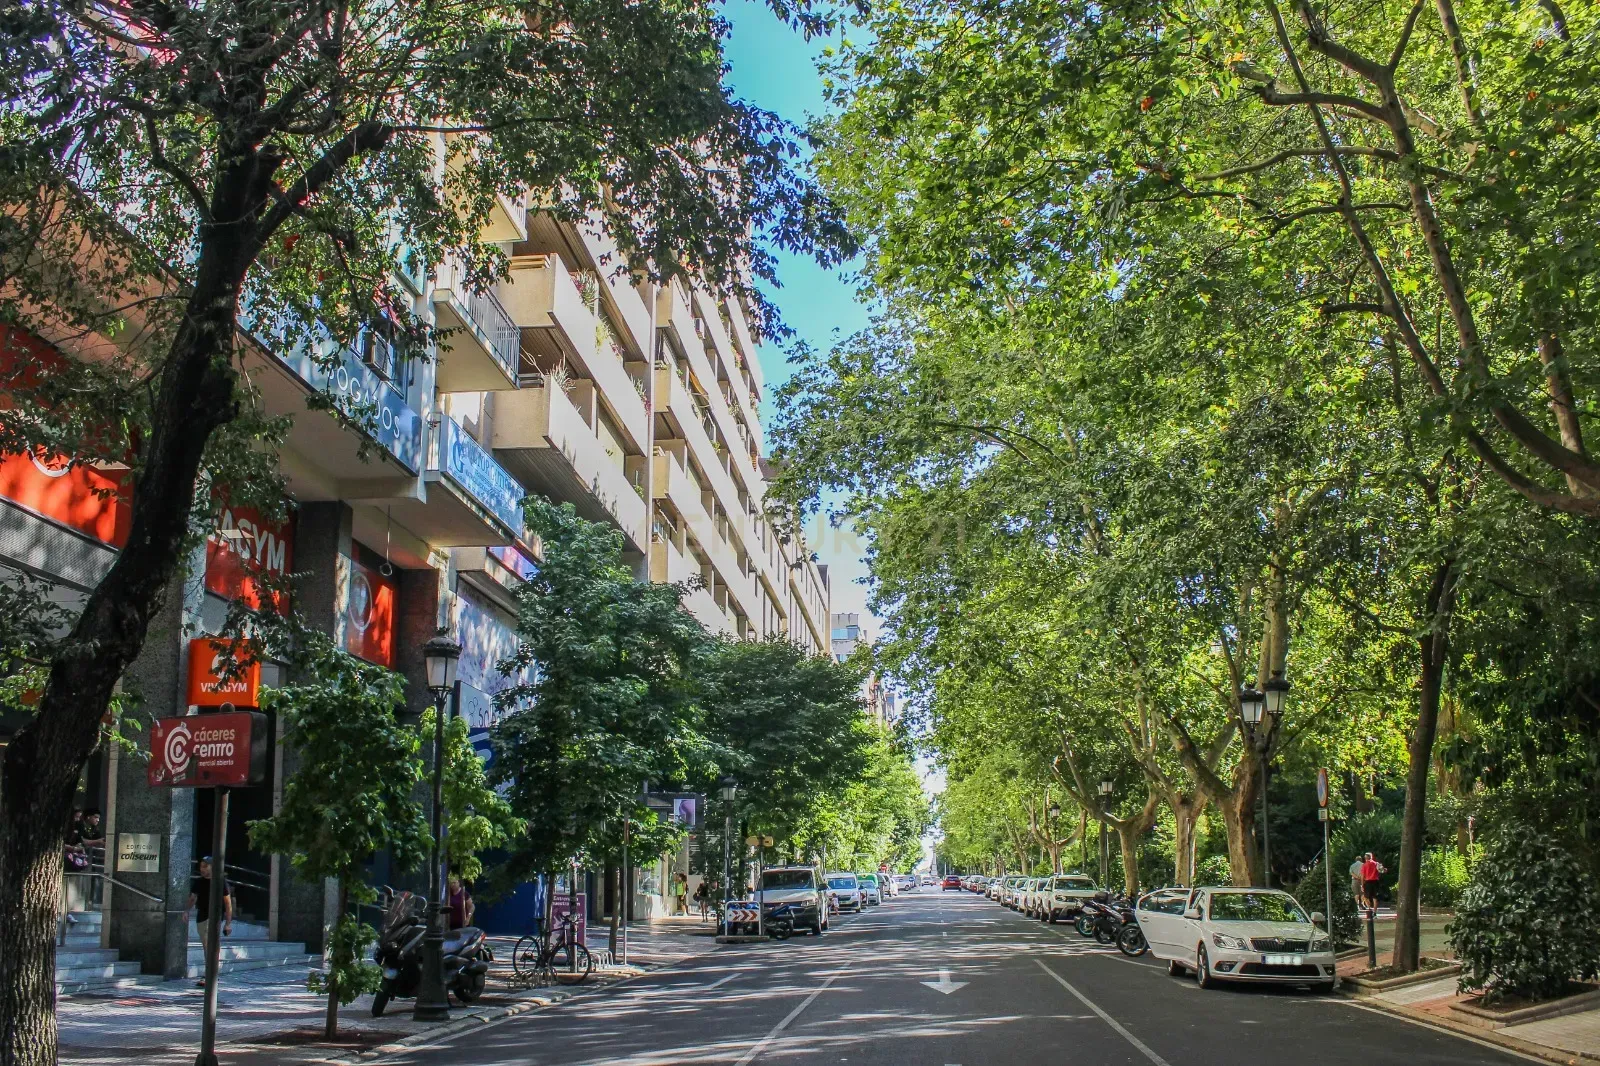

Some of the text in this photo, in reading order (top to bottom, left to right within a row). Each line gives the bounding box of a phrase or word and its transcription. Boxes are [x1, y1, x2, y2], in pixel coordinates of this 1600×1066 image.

[201, 682, 247, 693] VIVGYM
[193, 726, 236, 743] cáceres
[120, 851, 158, 861] coliseum
